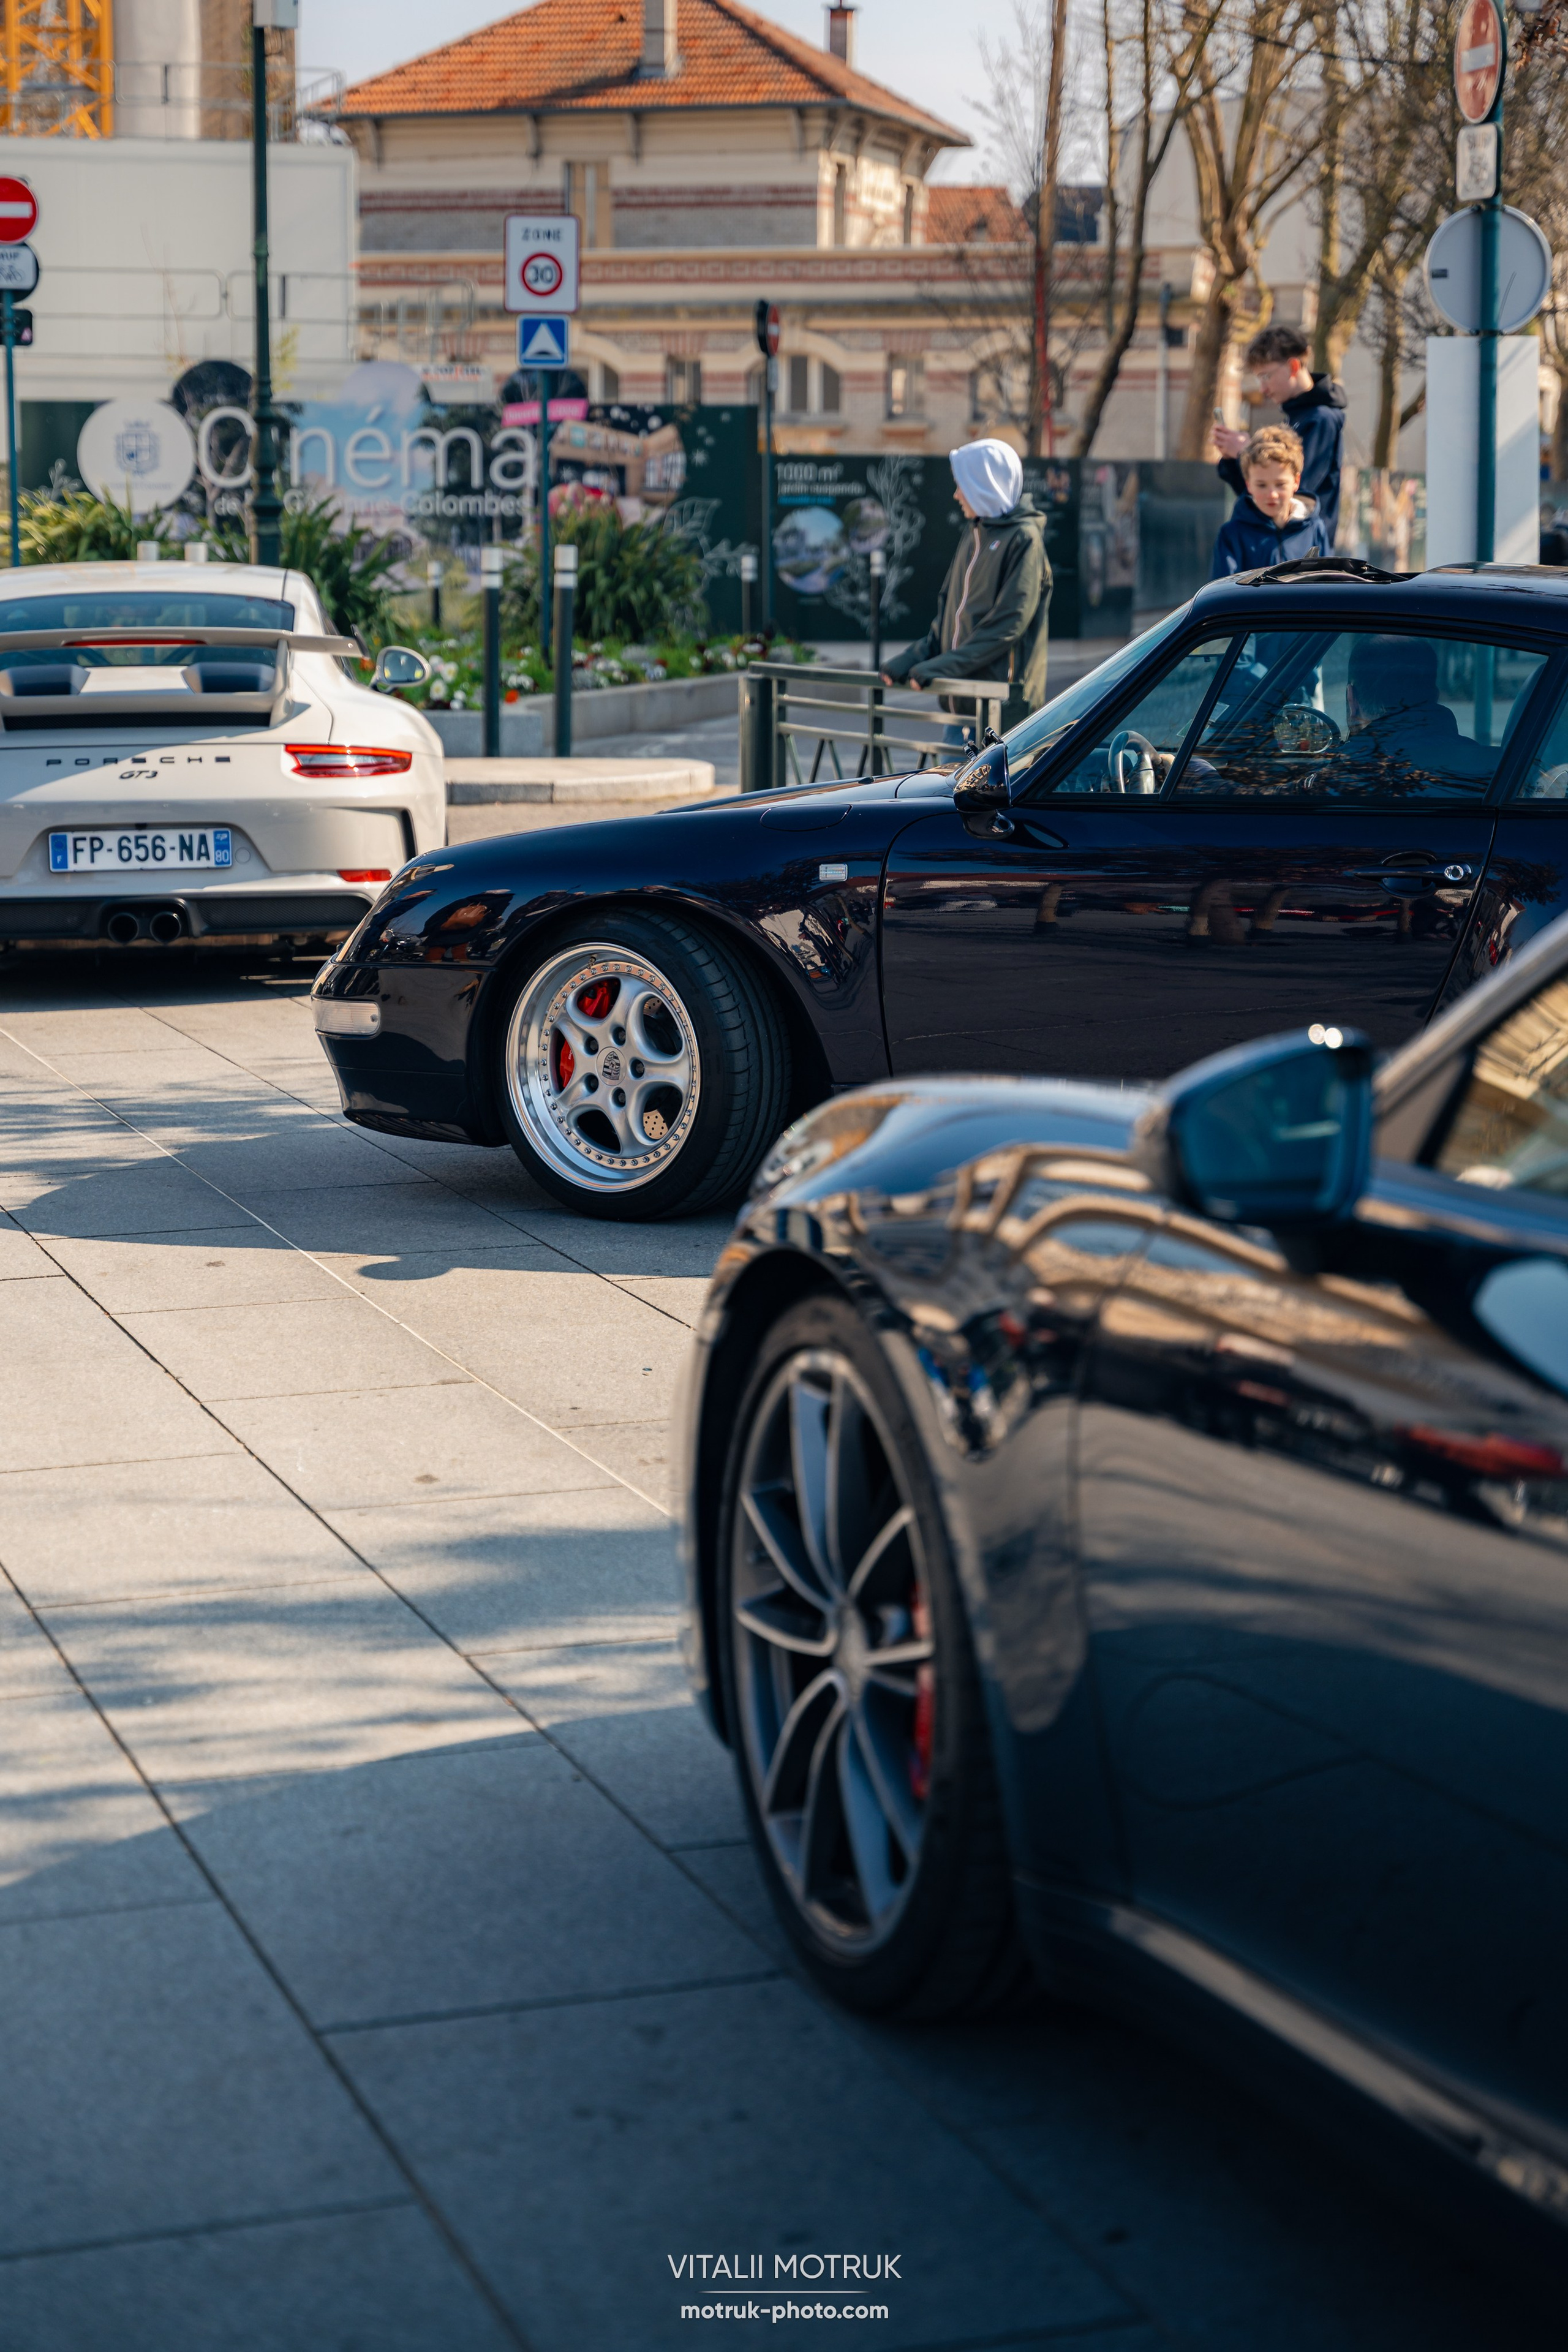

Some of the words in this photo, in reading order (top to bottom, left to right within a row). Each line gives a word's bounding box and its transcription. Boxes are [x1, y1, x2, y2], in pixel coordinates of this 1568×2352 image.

[521, 228, 562, 242] ZONE
[527, 265, 556, 285] 30
[197, 405, 538, 489] Cnéma
[401, 489, 532, 518] Colombes
[46, 756, 231, 767] PORSCHE
[119, 770, 159, 780] GT3
[72, 833, 211, 865] FP-656-NA
[215, 850, 229, 863] 80
